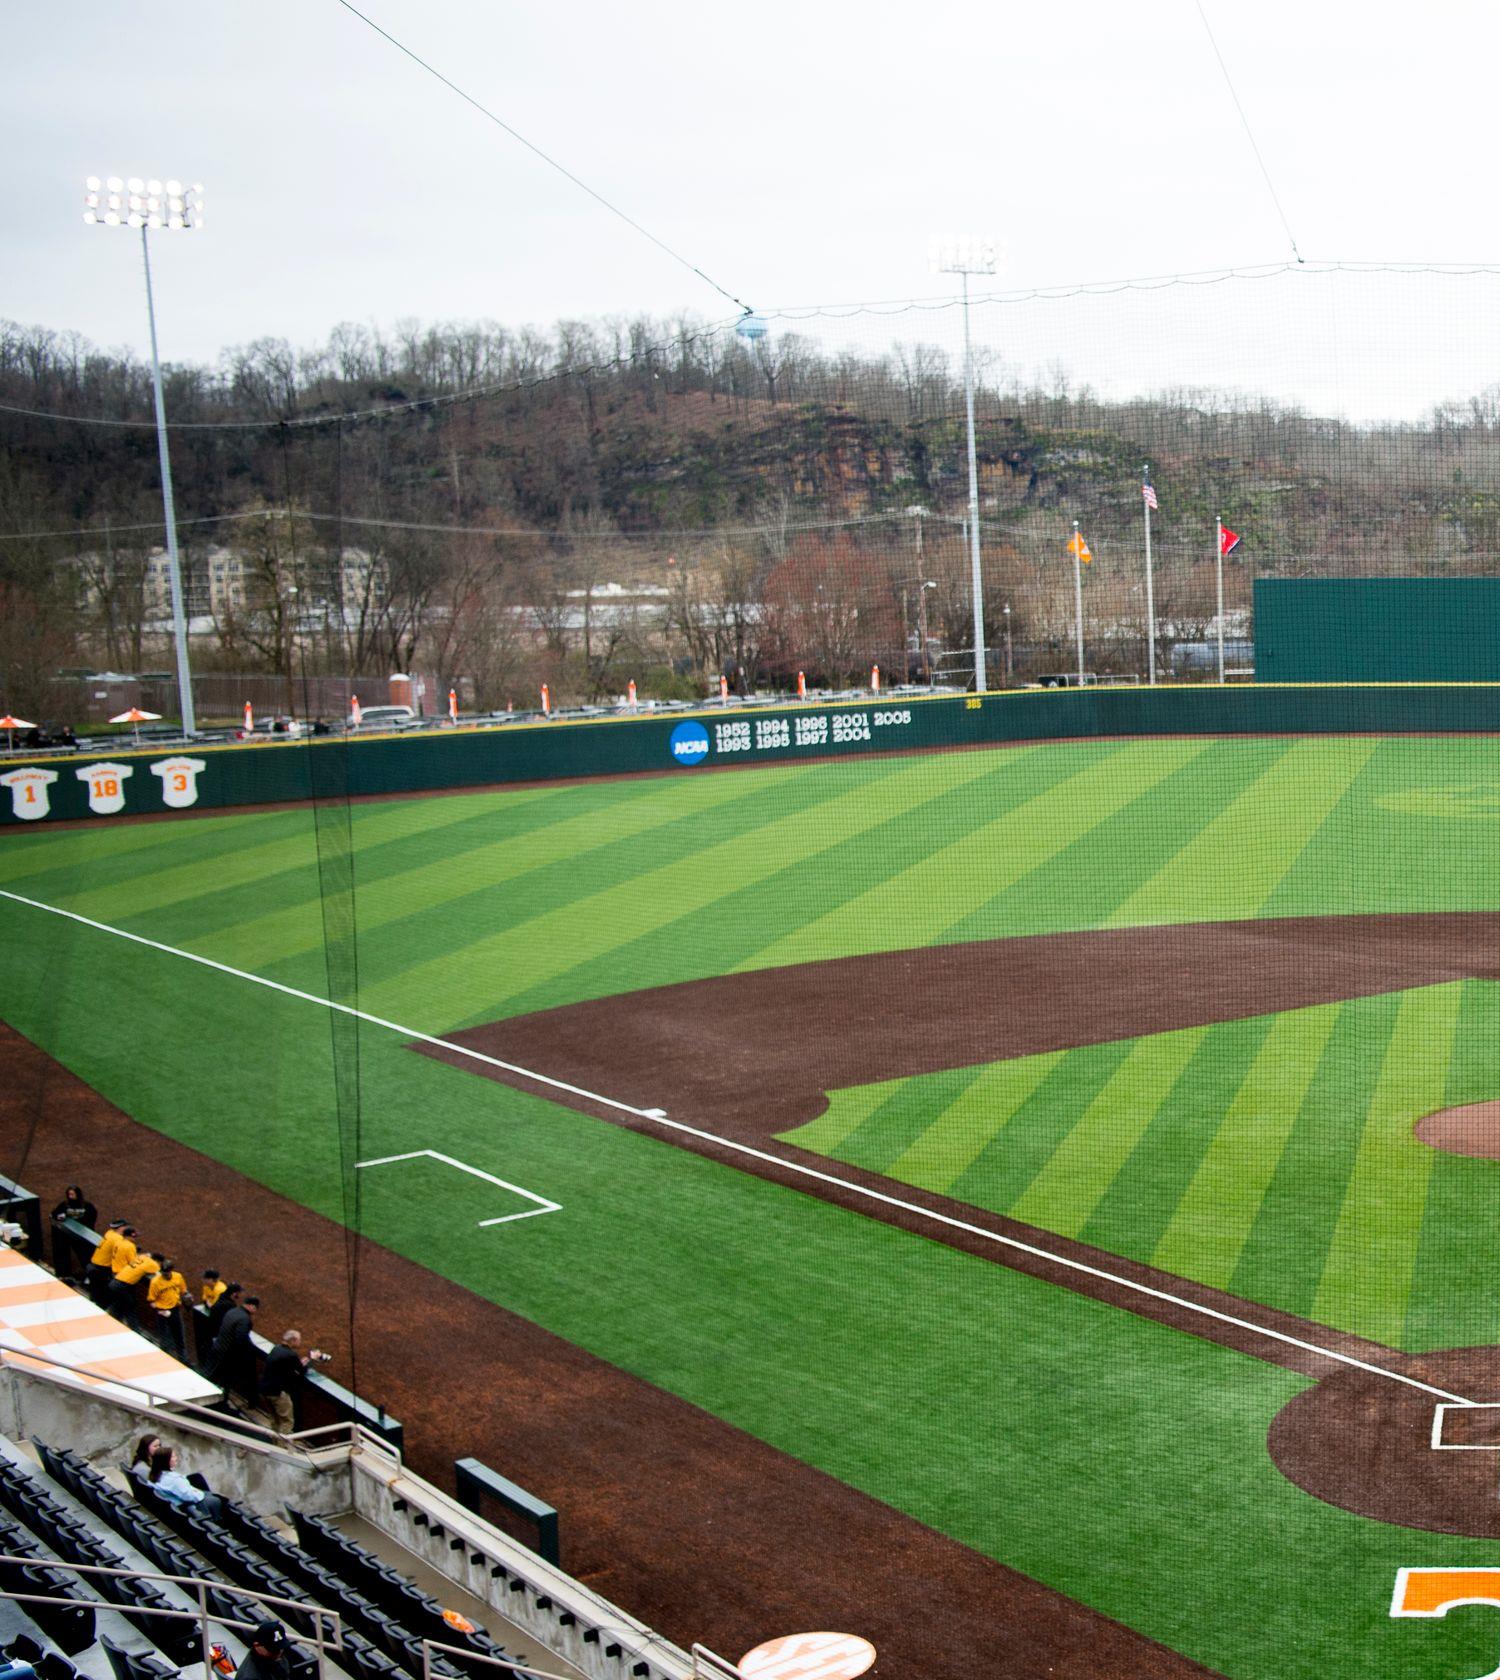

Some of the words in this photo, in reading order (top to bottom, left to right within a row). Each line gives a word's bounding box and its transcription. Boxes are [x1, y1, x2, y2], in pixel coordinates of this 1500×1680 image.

[715, 722, 750, 738] 1952
[755, 719, 789, 734] 1994
[832, 713, 869, 728] 2001
[874, 711, 911, 726] 2005
[675, 740, 709, 754] NCAA
[716, 736, 751, 752] 1993
[756, 733, 790, 749] 1995
[795, 730, 828, 745] 1997
[833, 727, 871, 742] 2004
[94, 780, 118, 798] 18
[173, 774, 187, 791] 3
[25, 784, 37, 803] 1
